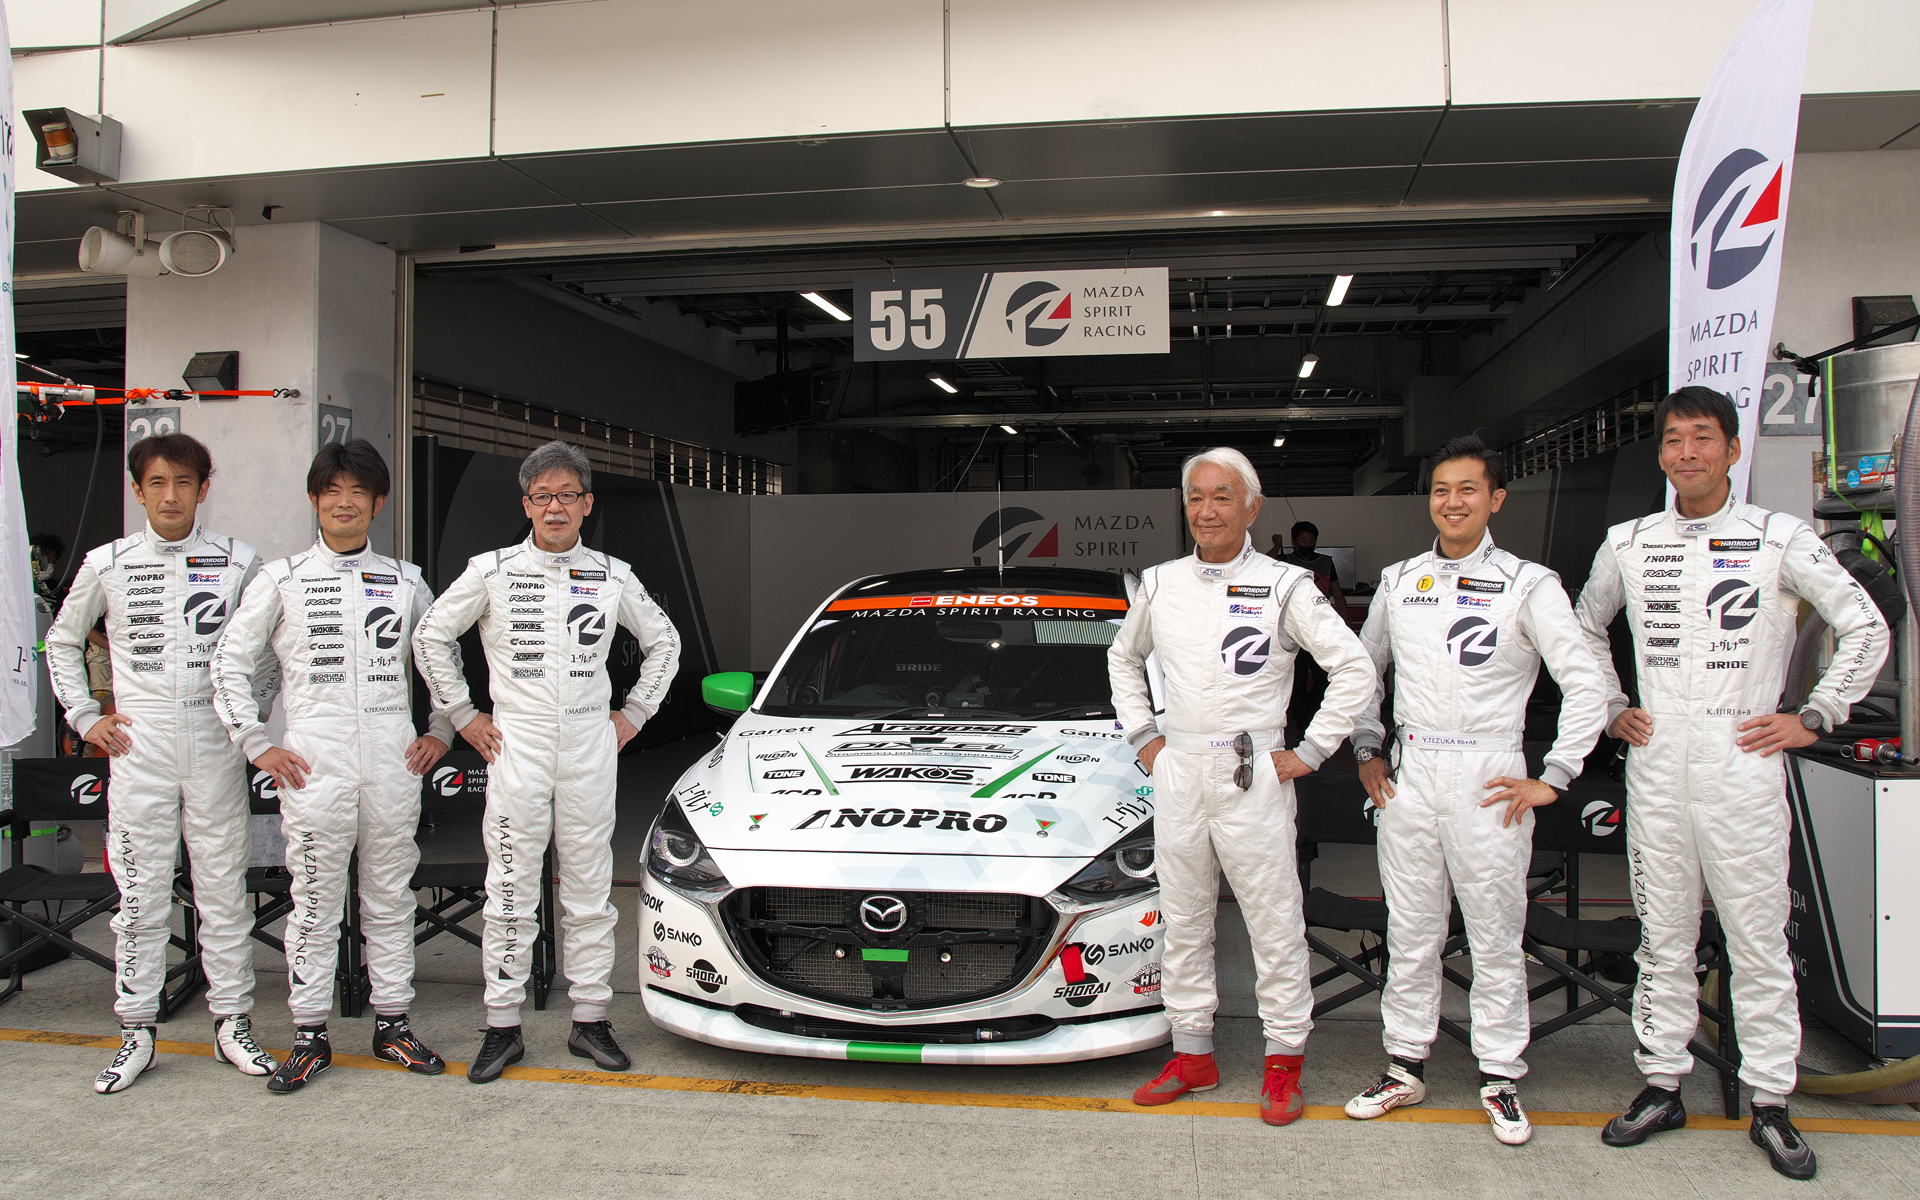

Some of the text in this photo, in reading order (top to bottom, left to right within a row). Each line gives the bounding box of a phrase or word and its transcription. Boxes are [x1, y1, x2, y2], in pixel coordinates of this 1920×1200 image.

[1083, 286, 1145, 299] MAZDA
[870, 288, 947, 351] 55
[1083, 305, 1133, 318] SPIRIT
[1083, 324, 1147, 338] RACING
[1688, 309, 1758, 346] MAZDA
[1687, 351, 1743, 383] SPIRIT
[1763, 374, 1822, 425] 27
[320, 414, 351, 446] 27
[1074, 515, 1155, 531] MAZDA
[1074, 541, 1139, 557] SPIRIT
[127, 587, 165, 596] RAYS
[305, 598, 342, 606] RAYS
[935, 595, 1039, 606] ENEOS
[851, 607, 1096, 618] MAZDA SPIRIT RACING
[896, 663, 942, 672] BRIDE
[1706, 660, 1748, 669] BRIDE
[1835, 668, 1858, 698] AZDA
[1854, 632, 1874, 666] SPIRIT
[425, 666, 444, 697] RACING
[738, 725, 815, 738] Garrett
[831, 723, 1035, 738] Aragosta
[1059, 728, 1123, 740] Garre
[1422, 737, 1456, 745] Y.TEZUKA
[755, 751, 798, 761] IBIDEN
[1056, 754, 1100, 764] IBIDEN
[767, 770, 802, 778] TONE
[1035, 773, 1073, 782] TONE
[830, 808, 1008, 833] NOPRO
[499, 815, 514, 875] MAZDA
[120, 830, 138, 890] MAZDA
[301, 830, 319, 925] MAZDA SPIRI
[1633, 848, 1649, 917] MAZDA
[502, 881, 514, 916] SPIRI
[667, 929, 703, 947] SANKO
[1108, 937, 1155, 957] SANKO
[686, 967, 728, 985] SHORAI
[1053, 981, 1112, 998] SHORAI
[1640, 971, 1655, 1037] RACING
